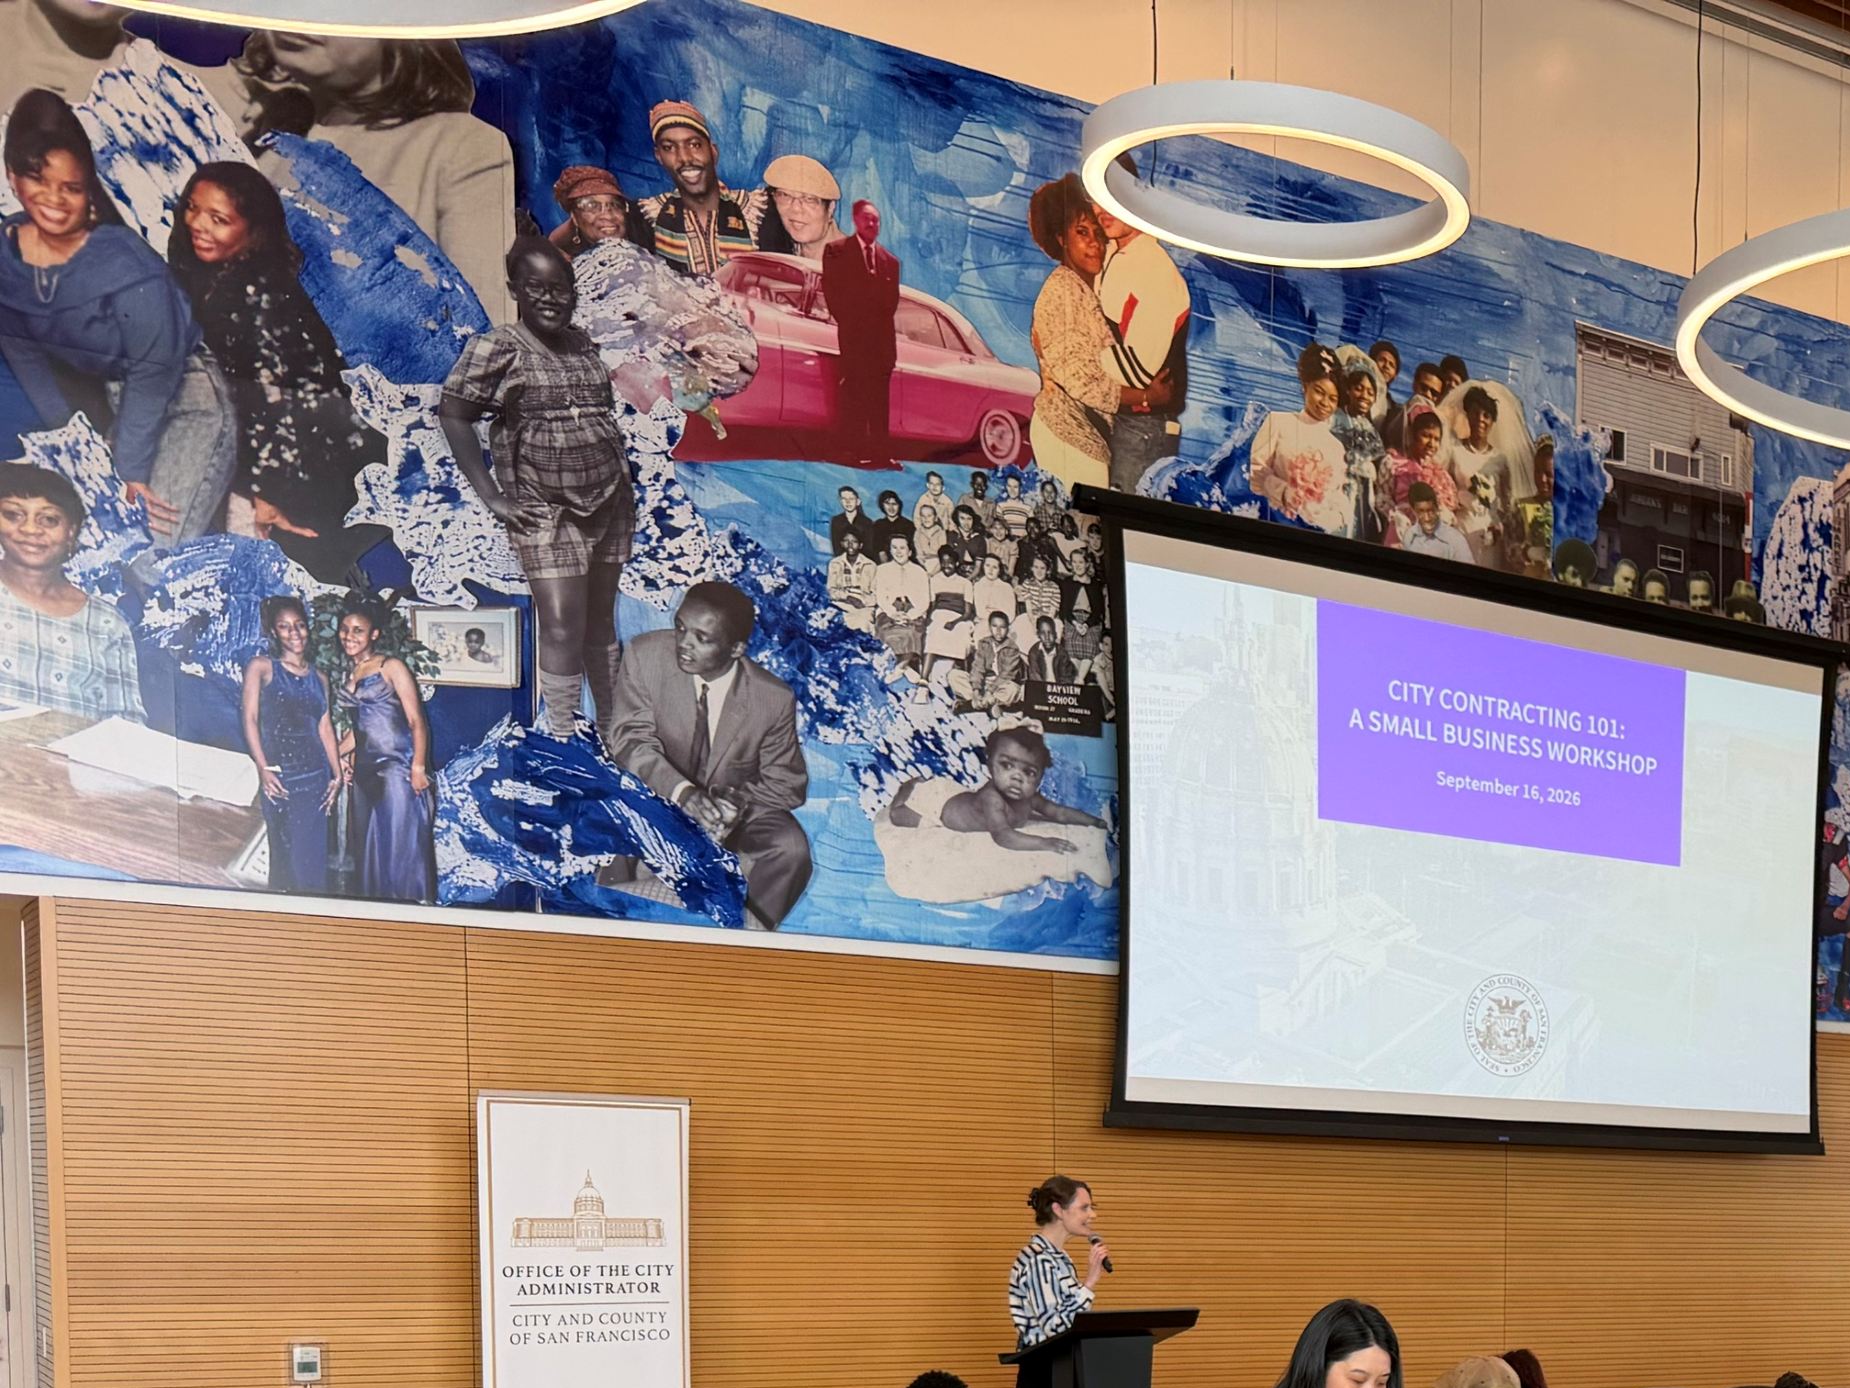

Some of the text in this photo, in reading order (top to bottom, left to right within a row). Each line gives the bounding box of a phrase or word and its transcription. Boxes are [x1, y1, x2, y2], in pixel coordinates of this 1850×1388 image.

[1047, 695, 1079, 706] SCHOOL
[1388, 679, 1626, 739] CITY CONTRACTING 101:
[1349, 708, 1658, 776] A SMALL BUSINESS WORKSHOP
[1436, 770, 1581, 806] September 16, 2026
[1468, 995, 1480, 1017] CITY
[1479, 979, 1496, 995] AND
[1497, 976, 1531, 993] COUNTY
[1531, 993, 1541, 1006] OF
[502, 1264, 674, 1278] OFFICE OF THE CITY
[517, 1281, 661, 1296] ADMINISTRATOR
[512, 1311, 667, 1327] CITY AND COUNTY
[510, 1328, 671, 1345] OF SAN FRANCISCO
